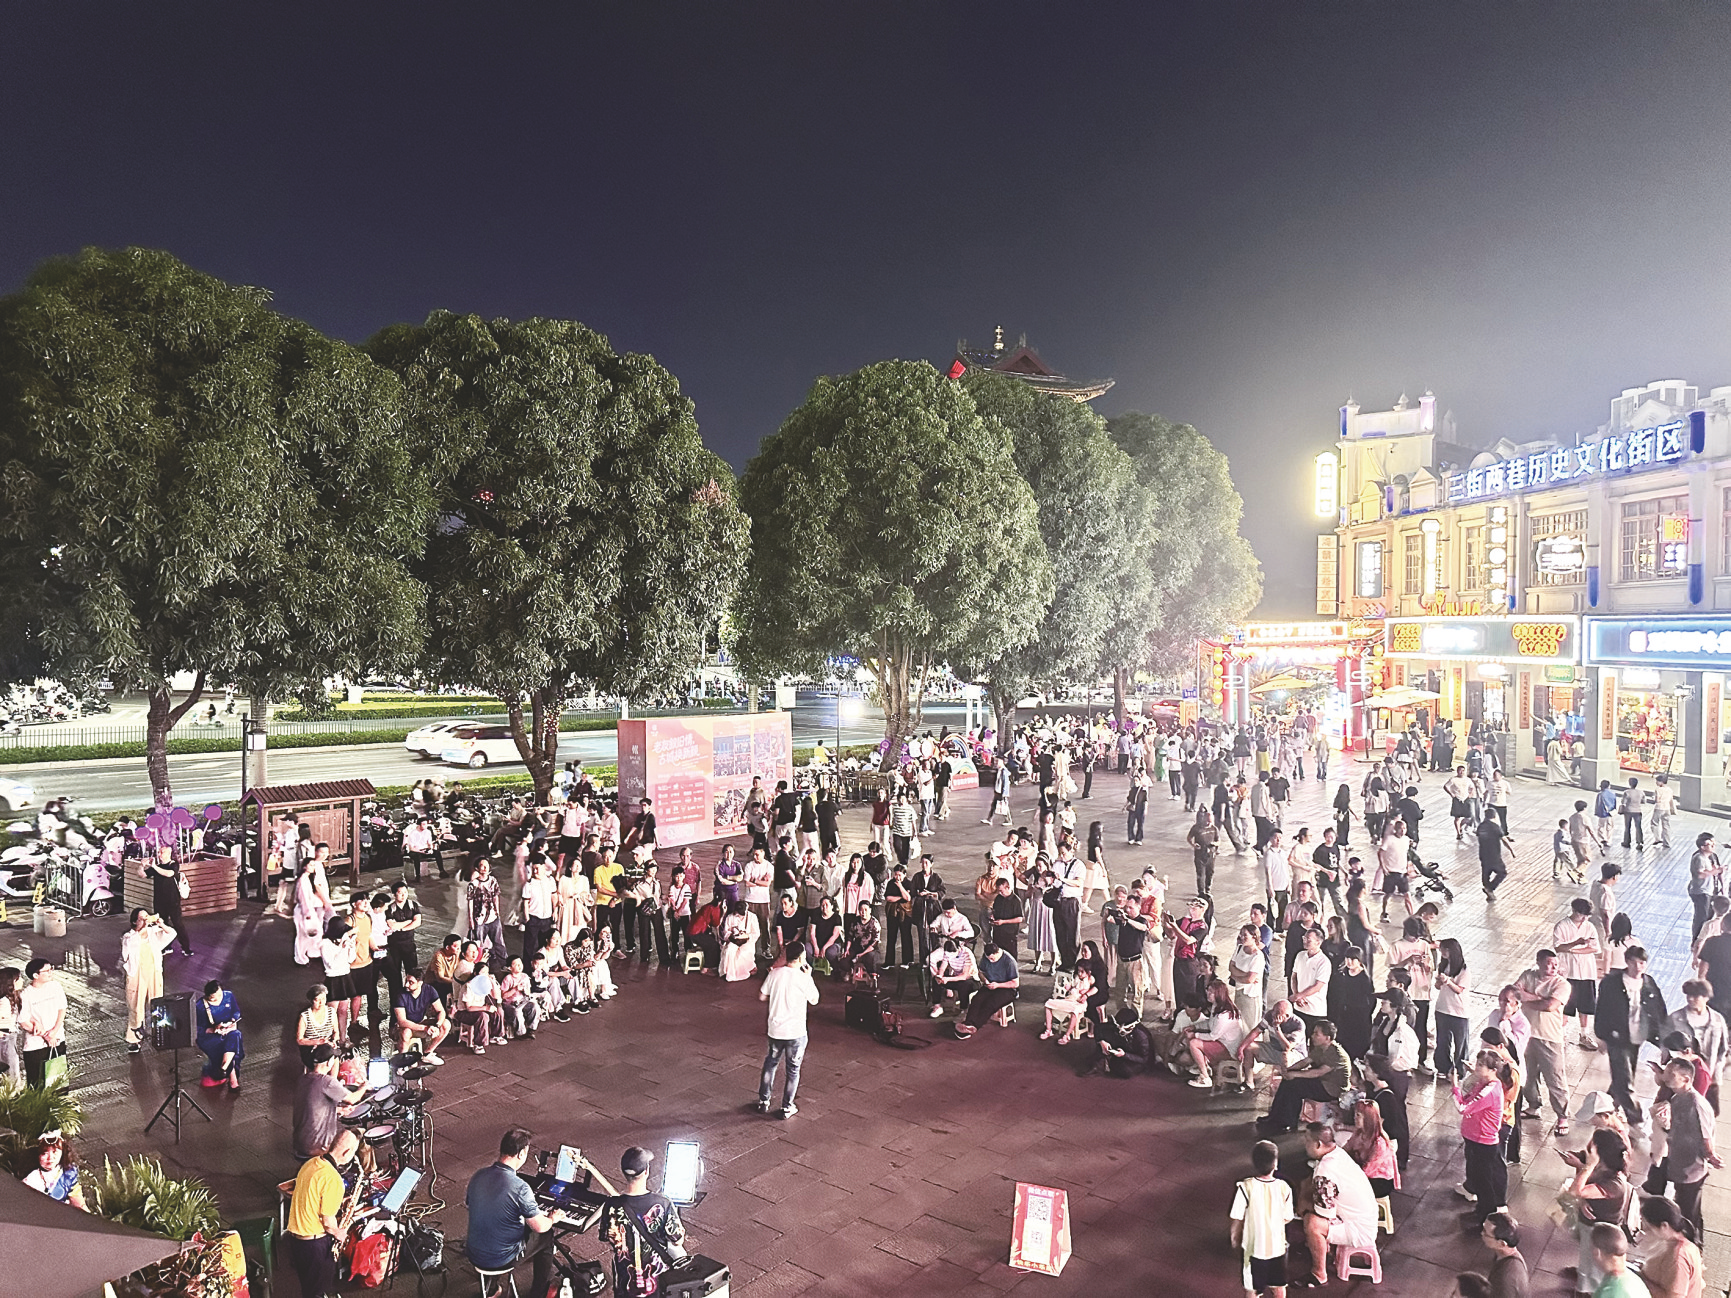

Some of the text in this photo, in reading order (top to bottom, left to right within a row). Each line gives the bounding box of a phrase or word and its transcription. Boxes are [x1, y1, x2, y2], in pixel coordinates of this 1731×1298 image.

[1448, 420, 1683, 501] 三街两巷历史文化街区
